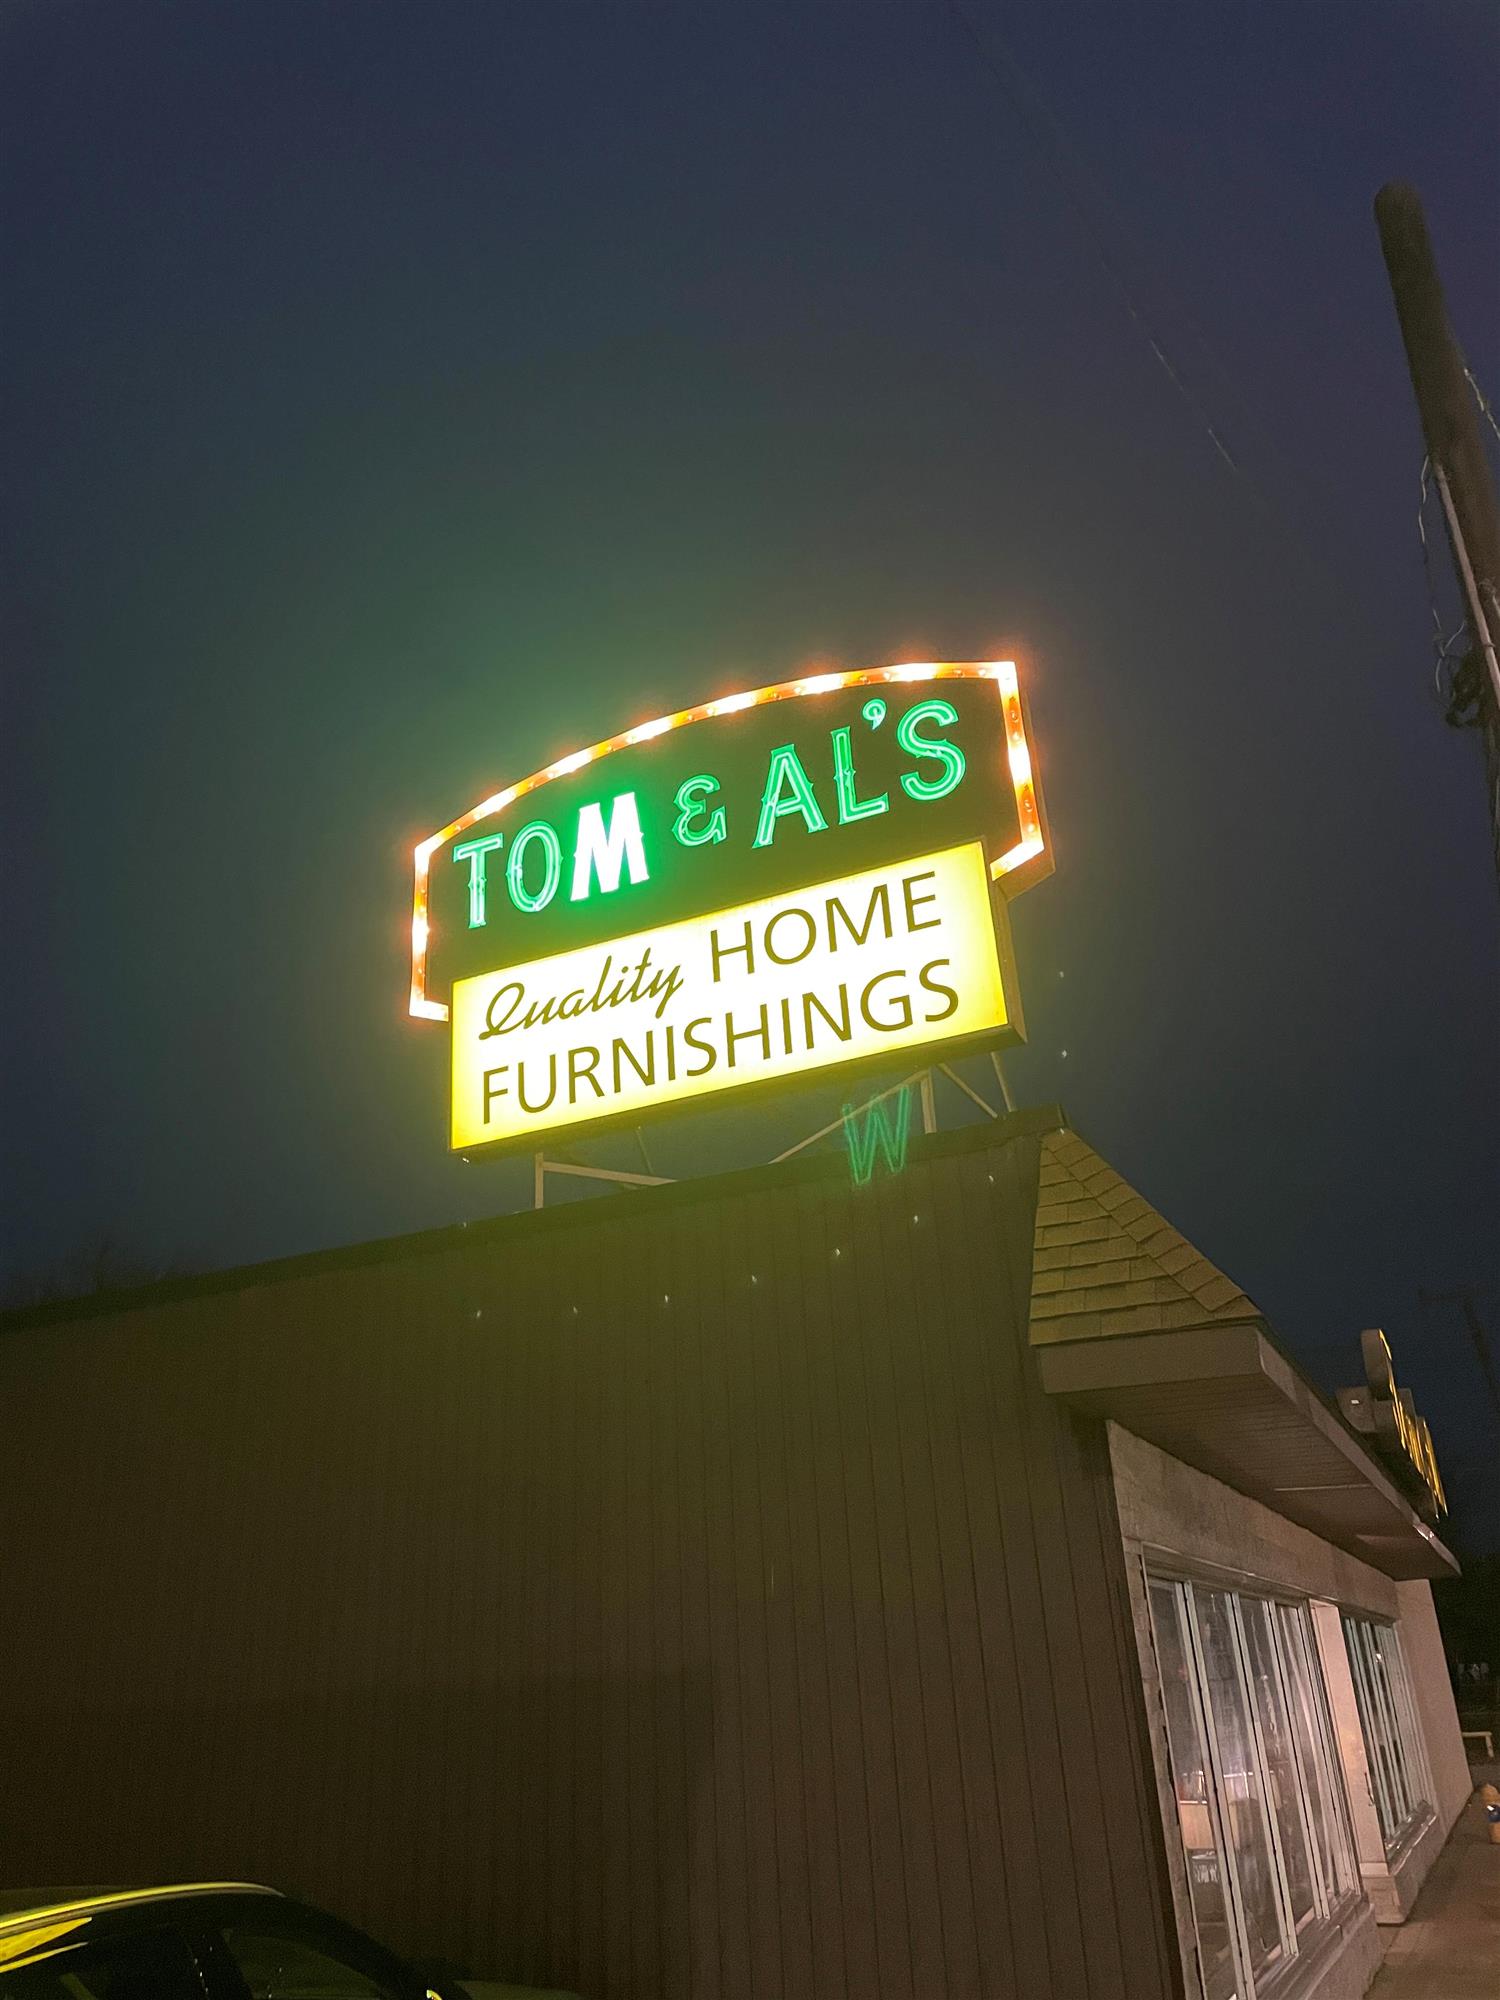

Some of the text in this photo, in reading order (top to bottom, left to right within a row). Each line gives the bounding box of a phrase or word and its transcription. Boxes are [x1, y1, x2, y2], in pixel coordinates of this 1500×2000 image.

[453, 699, 967, 930] TOM & AL'S
[478, 871, 942, 1041] Quality HOME
[482, 958, 960, 1125] FURNISHINGS
